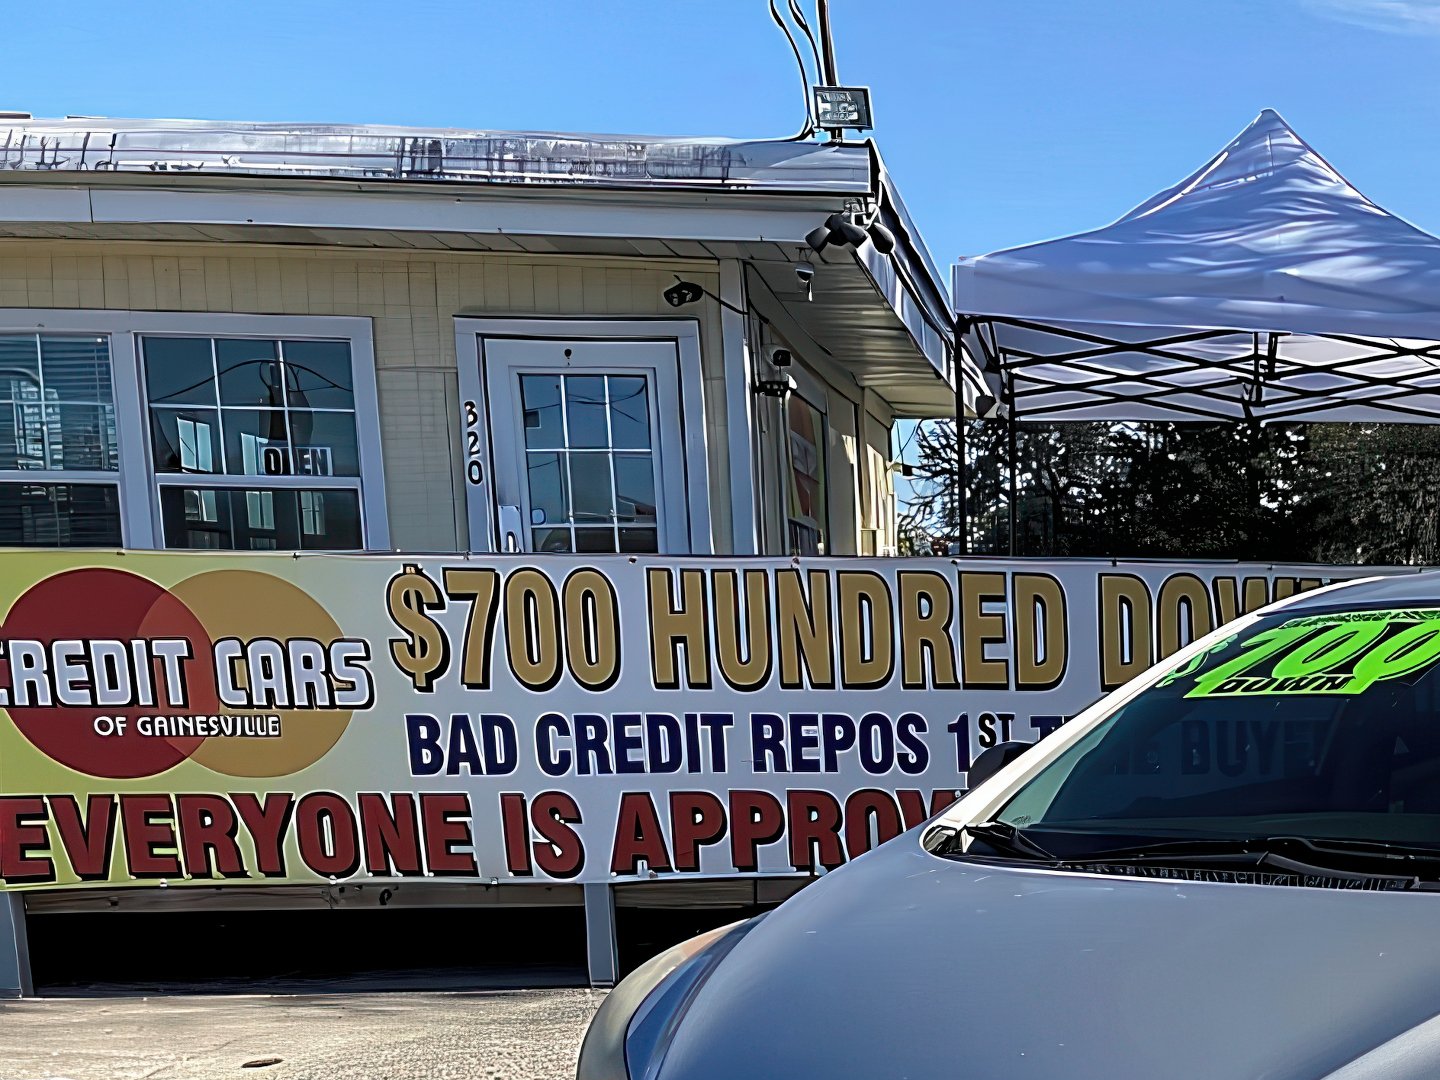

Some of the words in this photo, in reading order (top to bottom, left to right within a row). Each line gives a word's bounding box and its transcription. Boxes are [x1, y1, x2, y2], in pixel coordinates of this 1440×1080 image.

[464, 401, 483, 485] 320
[385, 563, 622, 693] $700
[647, 567, 1068, 692] HUNDRED
[1097, 572, 1325, 693] DO
[0, 636, 194, 709] REDIT
[210, 636, 376, 710] CARS
[1208, 676, 1354, 695] DOWN
[93, 714, 127, 737] OF
[136, 714, 282, 738] GAINESVILLE
[406, 713, 518, 776] BAD
[534, 712, 734, 776] CREDIT
[750, 712, 931, 775] REPOS
[947, 712, 1016, 773] 1ST
[0, 791, 480, 877] EVERYONE
[500, 791, 583, 876] IS
